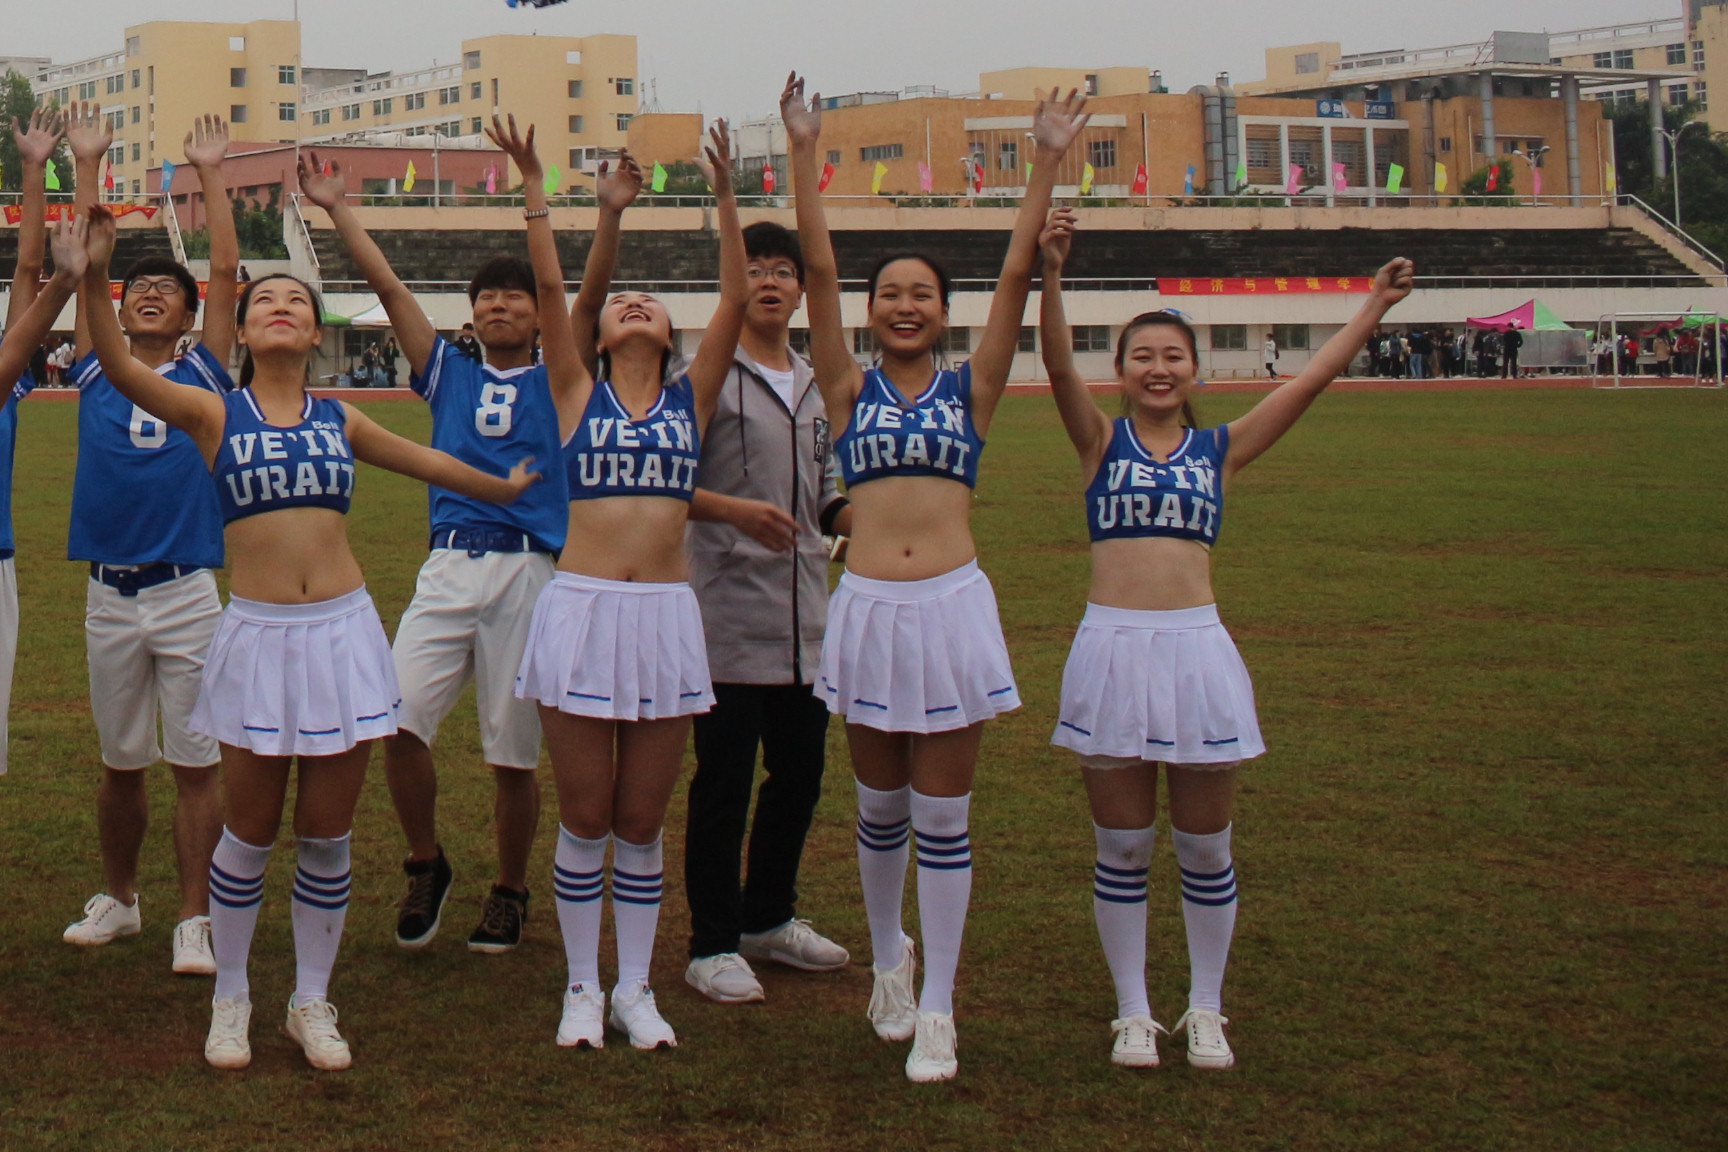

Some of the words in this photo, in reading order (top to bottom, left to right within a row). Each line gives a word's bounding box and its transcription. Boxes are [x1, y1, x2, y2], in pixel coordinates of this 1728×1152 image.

[475, 382, 517, 436] 8
[229, 429, 349, 465] VE'IN
[588, 417, 693, 452] VE'IN
[849, 433, 970, 476] URAIT
[226, 461, 355, 507] URAIT
[578, 453, 697, 492] URAIT
[1097, 493, 1217, 537] URAIT
